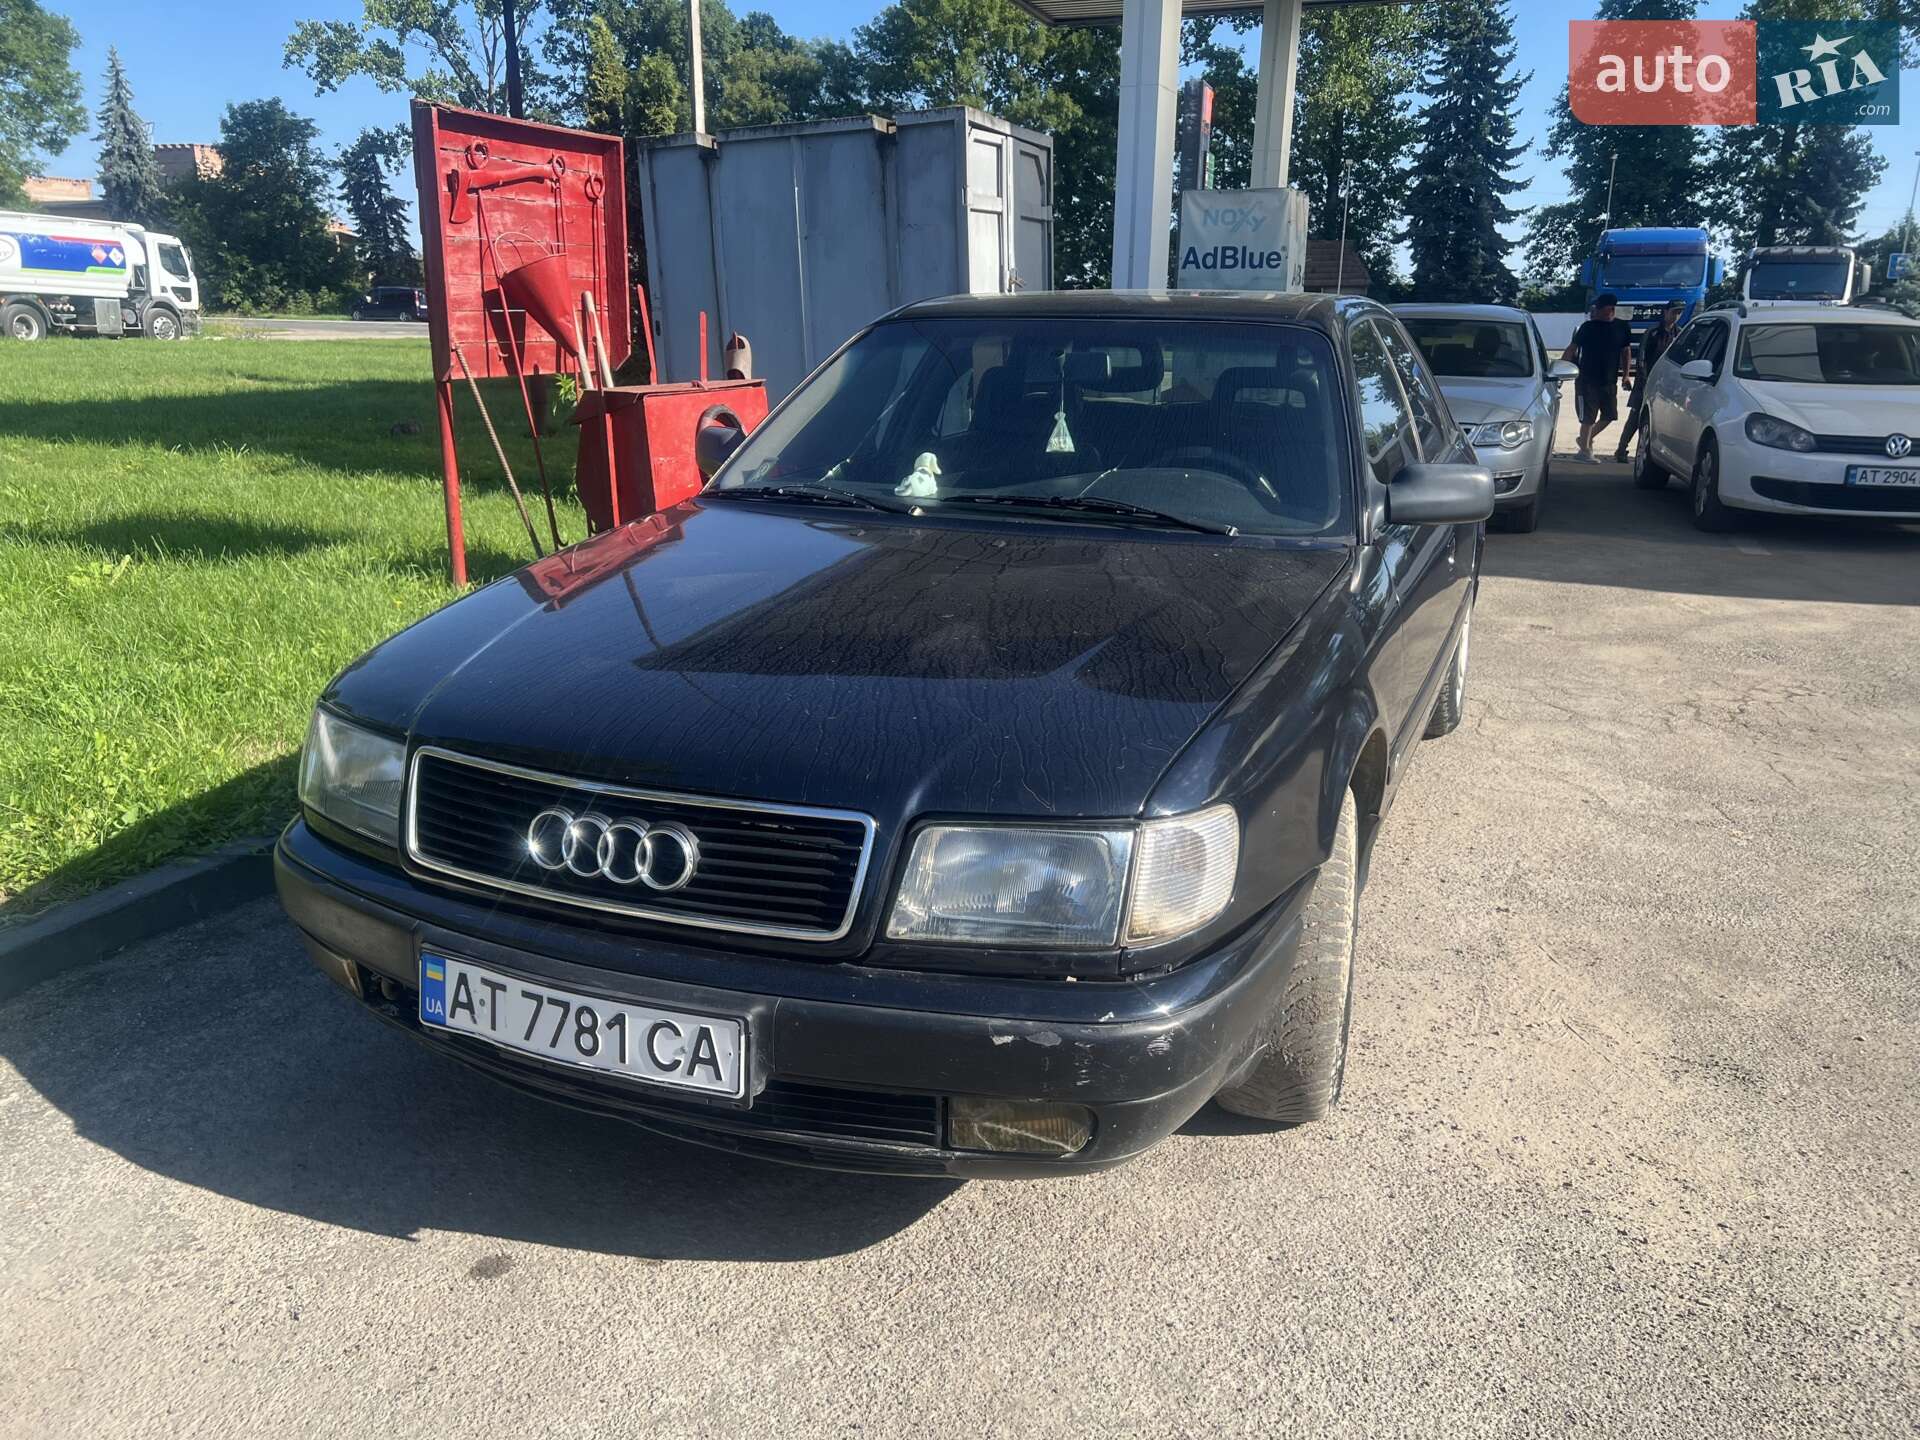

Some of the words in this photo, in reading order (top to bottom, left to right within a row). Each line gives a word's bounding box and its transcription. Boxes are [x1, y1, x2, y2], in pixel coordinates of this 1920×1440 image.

[1859, 469, 1881, 483] AT
[1883, 470, 1917, 484] 2904
[426, 996, 444, 1017] UA
[449, 971, 507, 1032] AT
[521, 989, 629, 1066] 7781
[647, 1018, 724, 1082] CA
